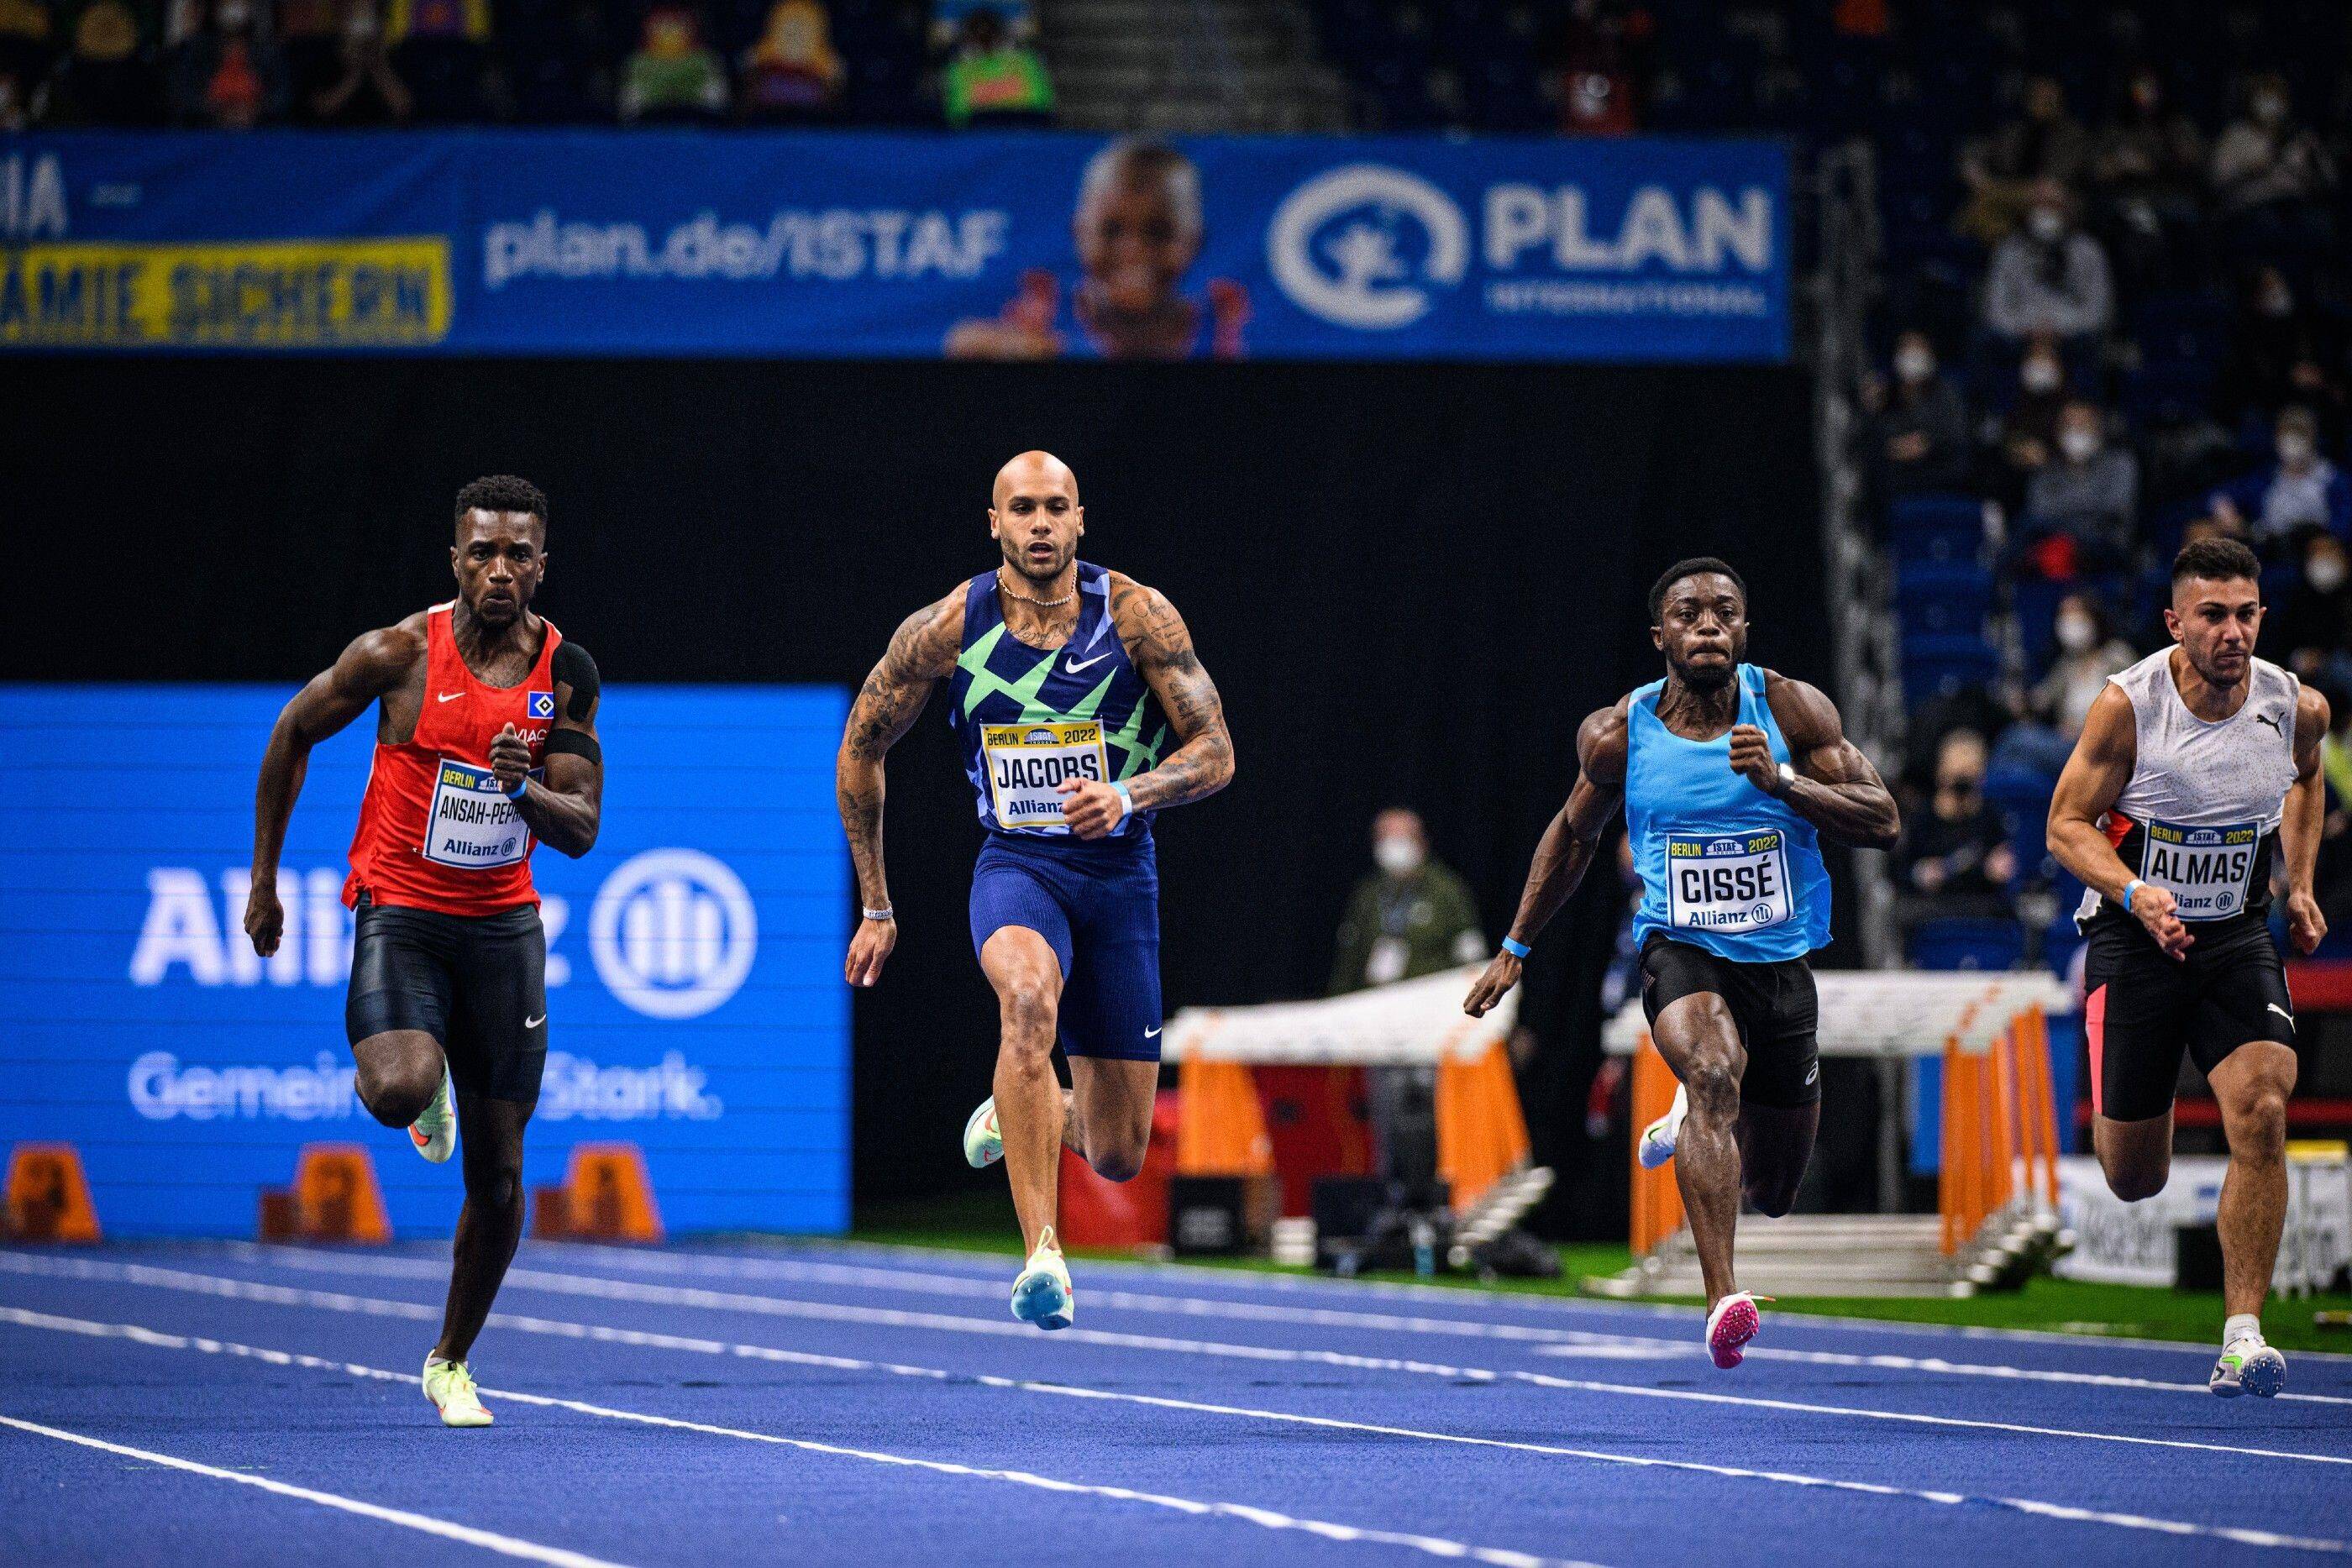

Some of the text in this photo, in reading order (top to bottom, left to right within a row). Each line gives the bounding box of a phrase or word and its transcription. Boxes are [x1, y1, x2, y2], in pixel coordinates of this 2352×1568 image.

[1483, 185, 1771, 270] PLAN
[486, 208, 1005, 287] plan.de/ISTAF
[987, 728, 1097, 746] BERLIN ISTAF 2022
[443, 768, 475, 789] BERLIN
[997, 753, 1099, 789] JACOBS
[1671, 835, 1777, 857] BERLIN ISTAF 2022
[2151, 826, 2182, 844] BERLIN
[2225, 830, 2255, 844] 2022
[443, 838, 499, 857] Allianz
[2150, 847, 2248, 885] ALMAS
[1681, 854, 1776, 904] CISSÉ
[1688, 910, 1747, 926] Allianz
